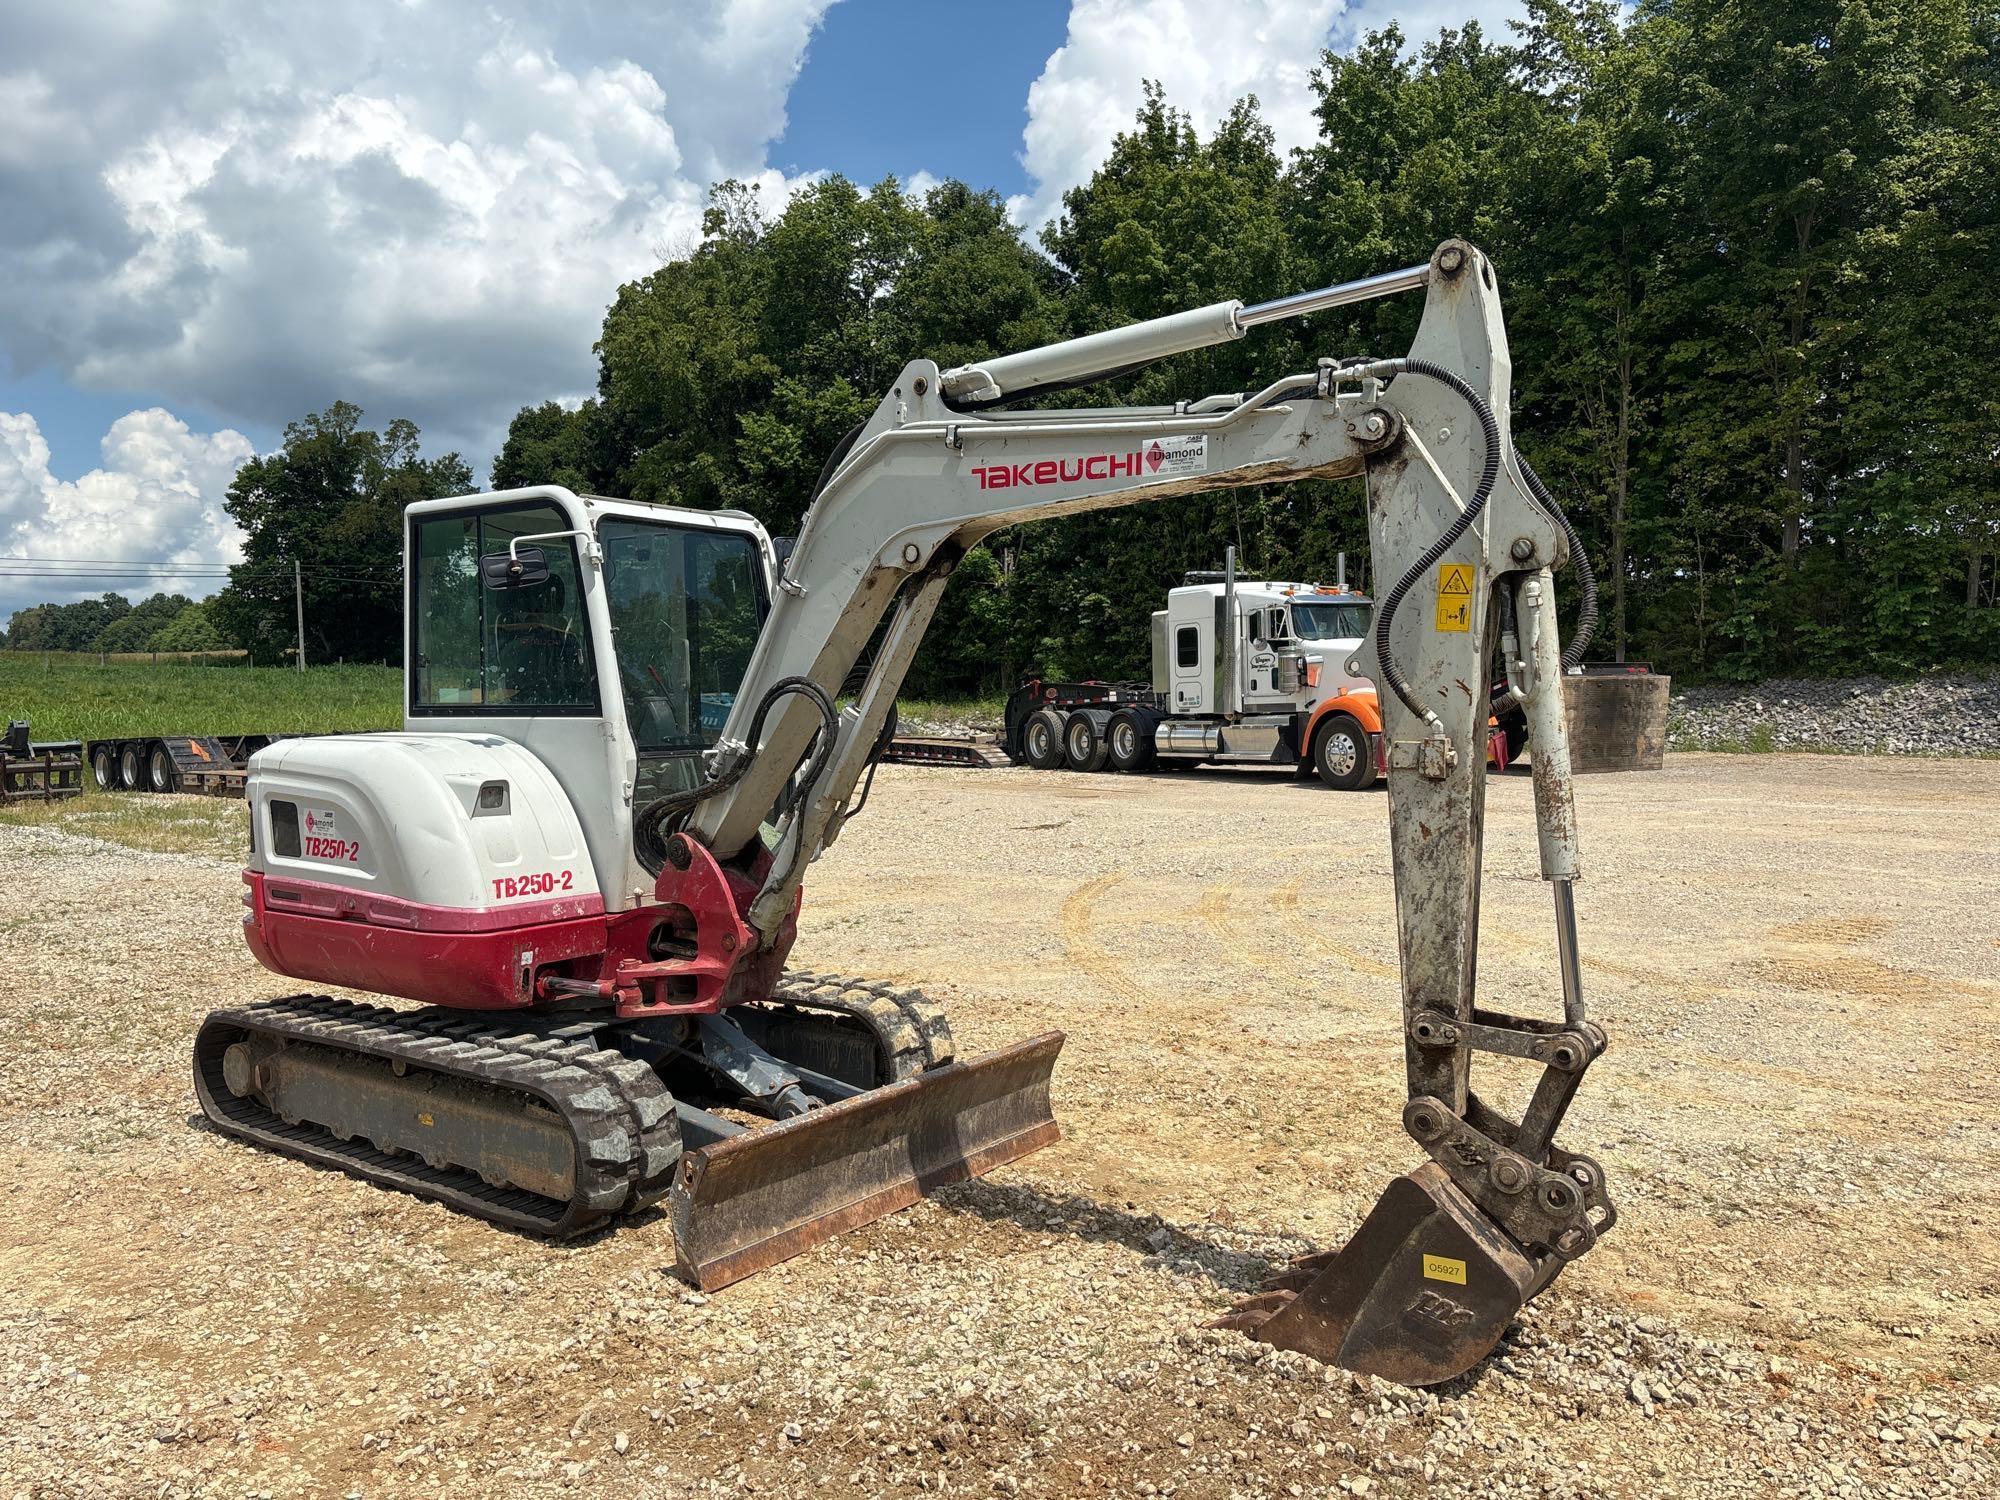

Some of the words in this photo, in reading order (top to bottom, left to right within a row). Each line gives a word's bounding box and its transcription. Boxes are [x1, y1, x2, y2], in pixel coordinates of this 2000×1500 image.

[1154, 446, 1203, 461] Diamond
[305, 836, 360, 861] TB250-2
[492, 870, 573, 899] TB250-2
